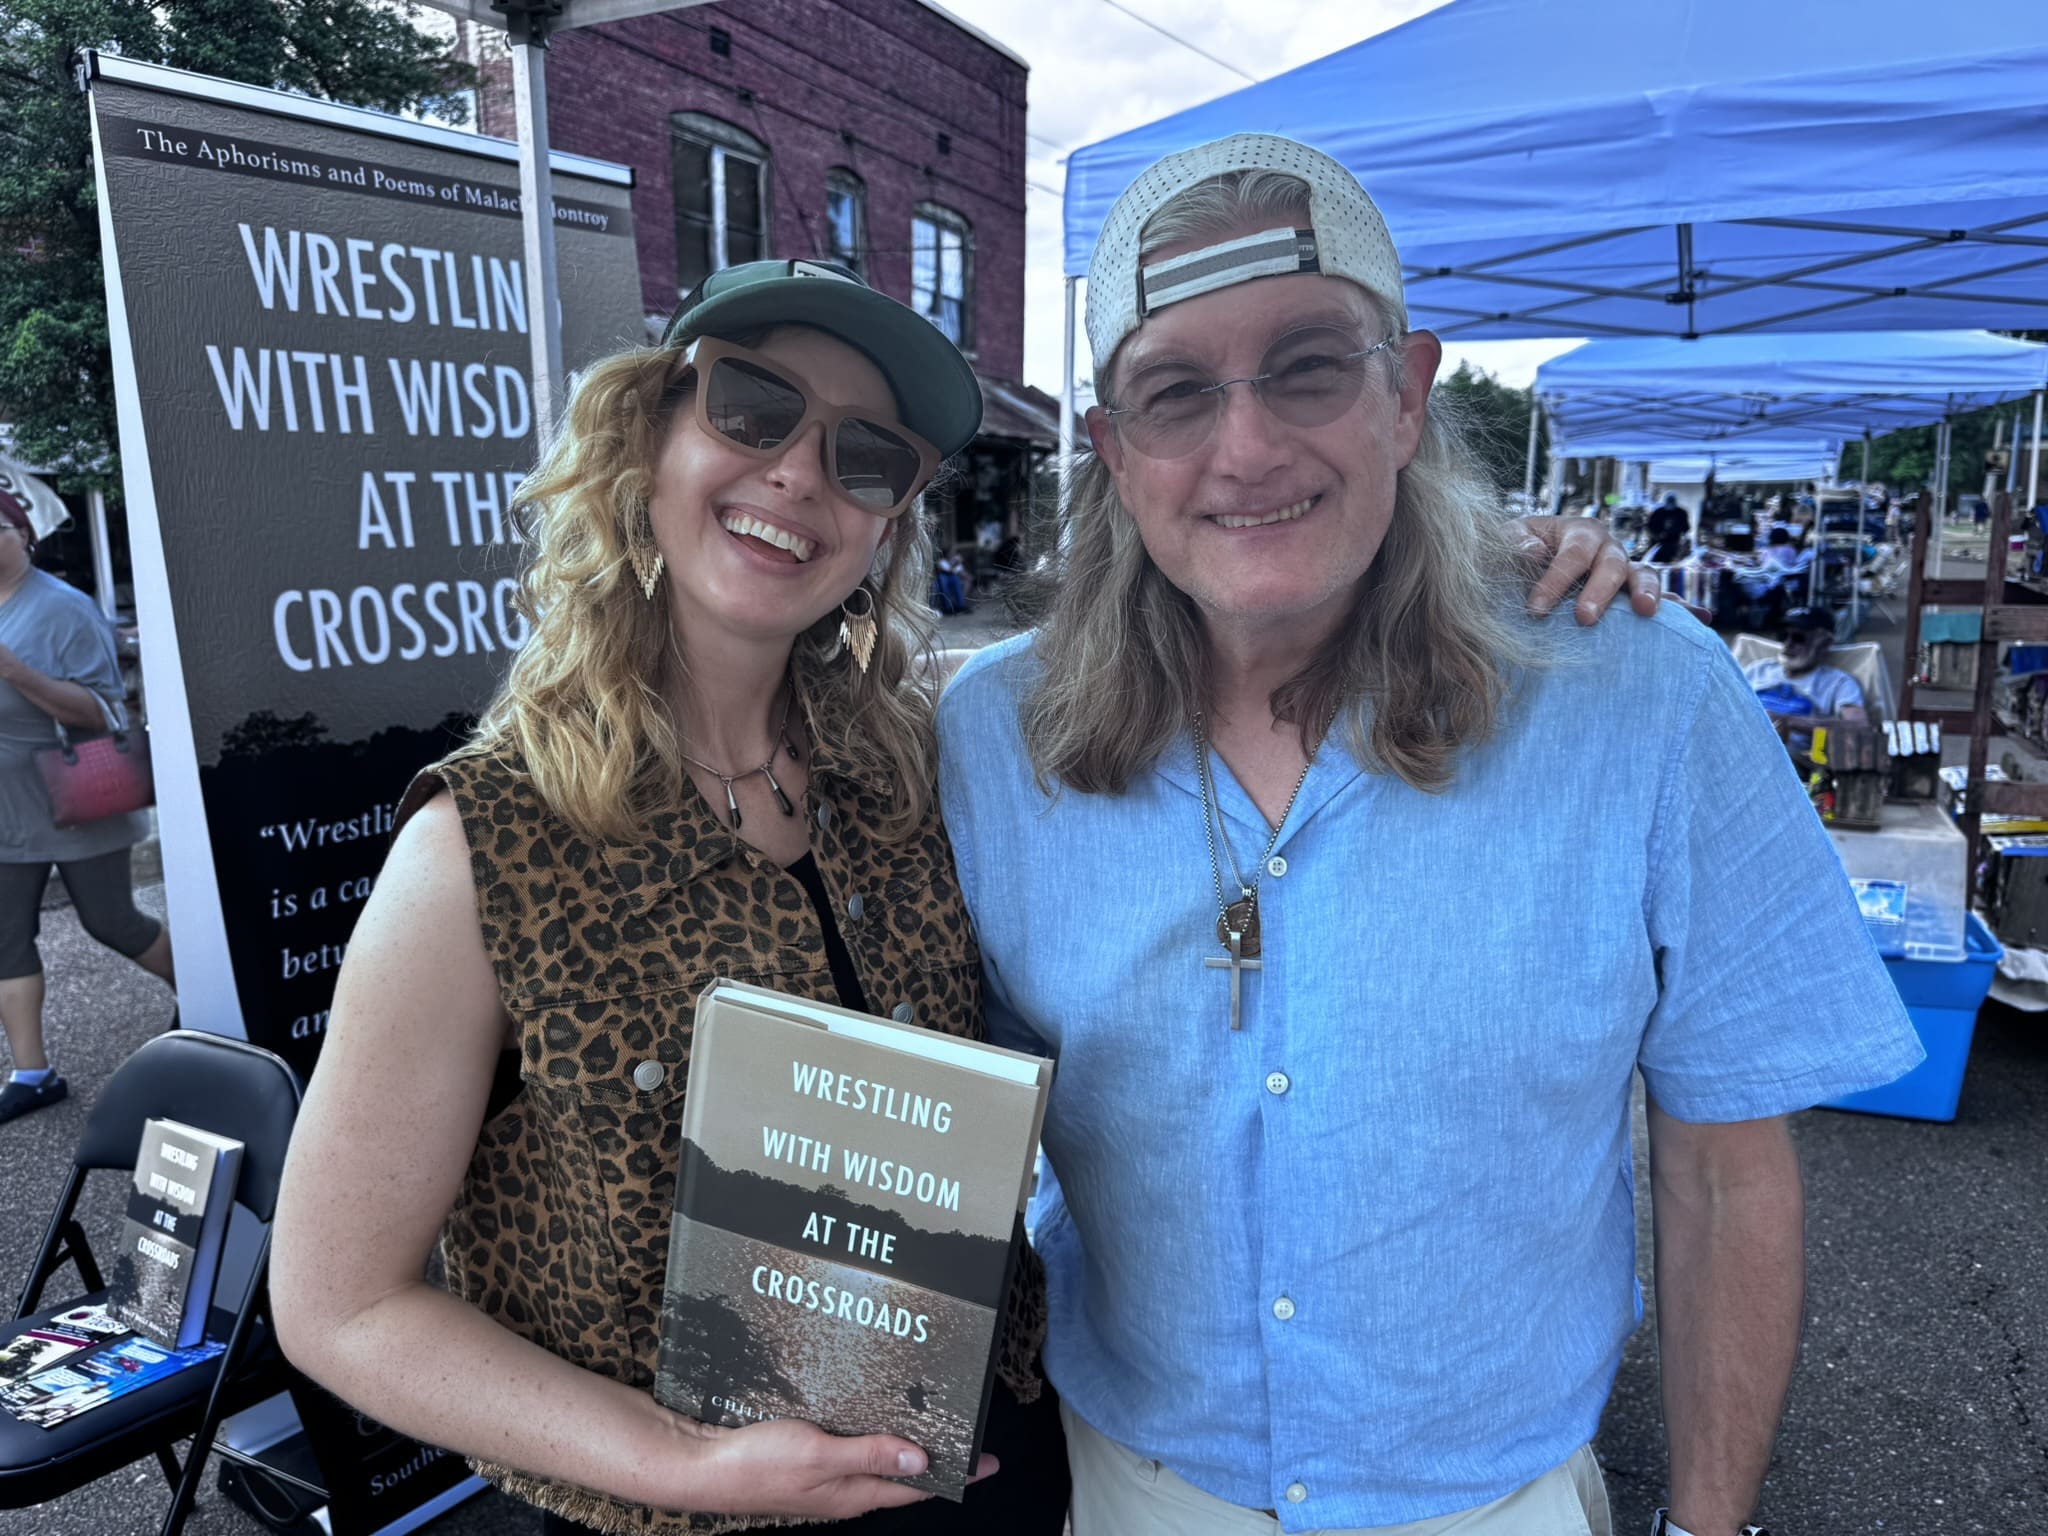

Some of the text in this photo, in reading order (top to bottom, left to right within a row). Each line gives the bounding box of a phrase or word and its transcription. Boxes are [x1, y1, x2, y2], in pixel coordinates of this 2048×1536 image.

[136, 128, 609, 231] The Aphorisms and Poems of Malac ontroy
[238, 222, 562, 336] WRESTLIN
[205, 344, 530, 440] WITH WISD
[358, 471, 416, 549] AT
[273, 579, 530, 673] CROSSRO
[259, 803, 392, 852] “Wrestli
[271, 876, 371, 919] is a ca
[292, 1009, 331, 1040] an
[792, 1061, 953, 1133] WRESTLING
[762, 1125, 960, 1212] WITH WISDOM
[802, 1211, 897, 1264] AT THE
[751, 1265, 929, 1343] CROSSROADS
